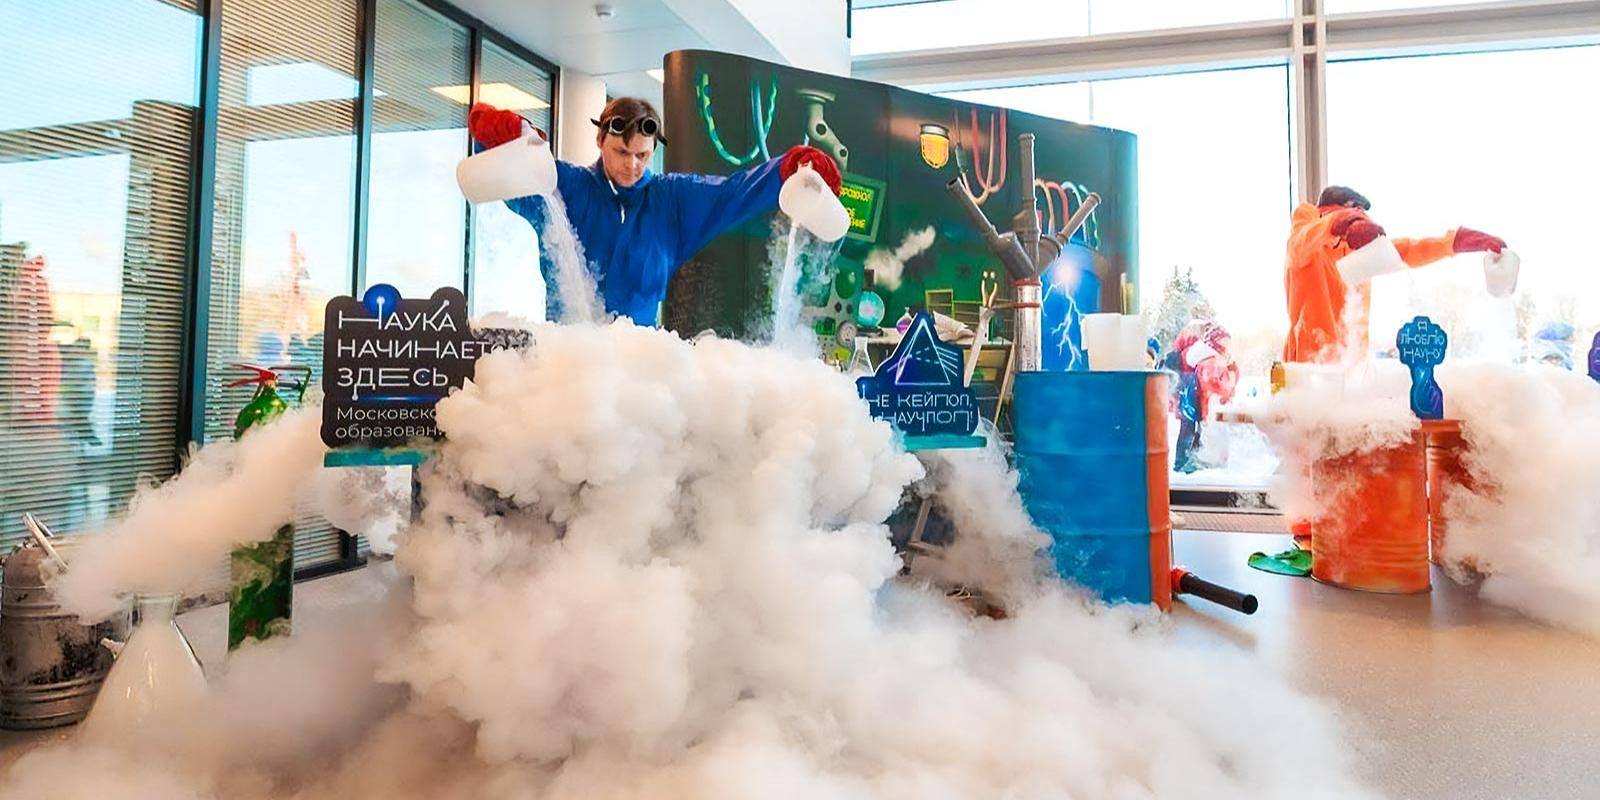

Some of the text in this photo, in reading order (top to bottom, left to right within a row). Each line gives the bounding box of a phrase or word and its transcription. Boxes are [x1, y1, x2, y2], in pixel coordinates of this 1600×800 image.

[338, 296, 457, 332] НАУКА
[337, 367, 449, 400] ЗДЕСЬ
[335, 424, 443, 441] образован
